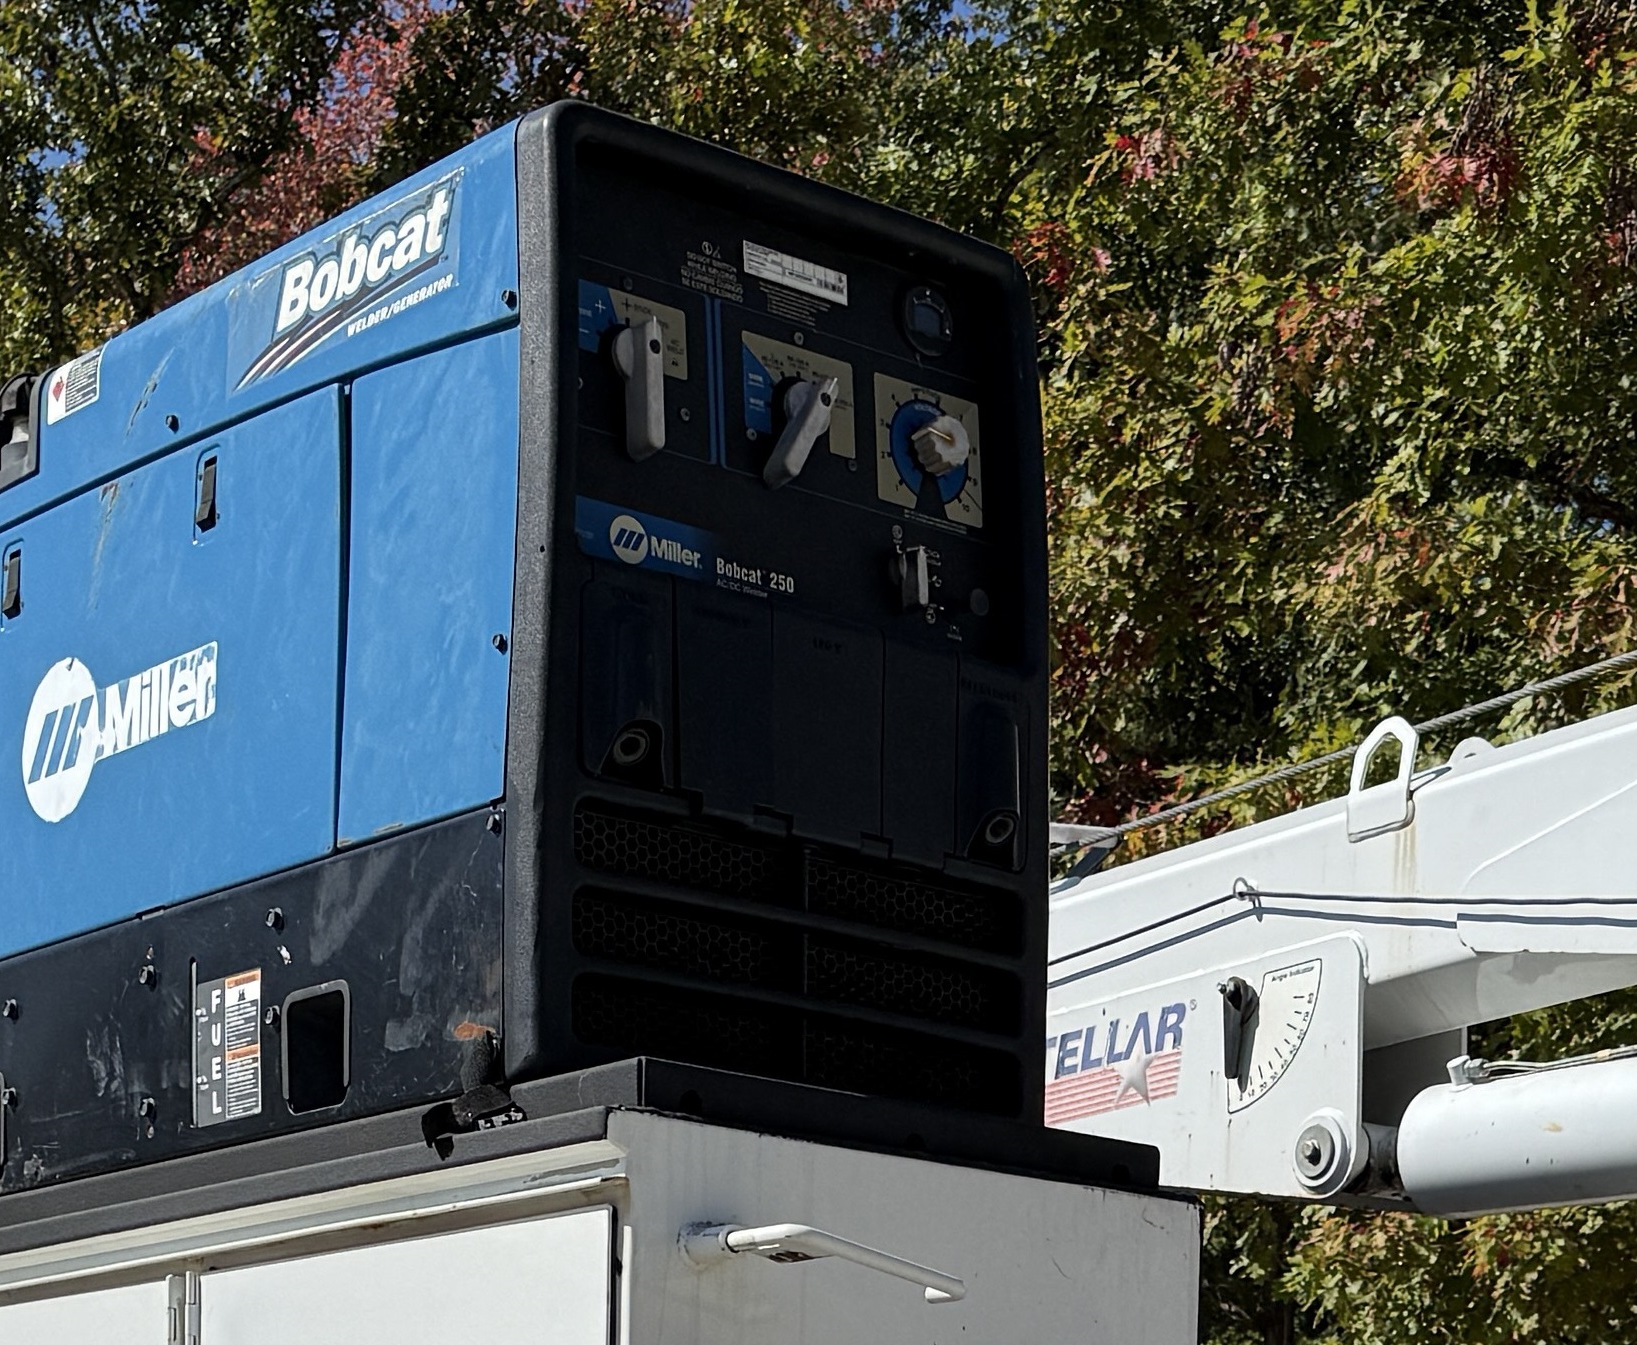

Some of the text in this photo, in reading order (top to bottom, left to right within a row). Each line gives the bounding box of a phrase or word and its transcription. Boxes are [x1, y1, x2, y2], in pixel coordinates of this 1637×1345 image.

[276, 188, 450, 333] Bobcat
[346, 273, 454, 338] WELDER/GENERATOR
[650, 535, 702, 569] Miller
[716, 556, 795, 594] Bobcat 250
[105, 650, 216, 756] Miller
[210, 988, 223, 1115] FUEL
[1047, 1001, 1187, 1081] ELLAR
